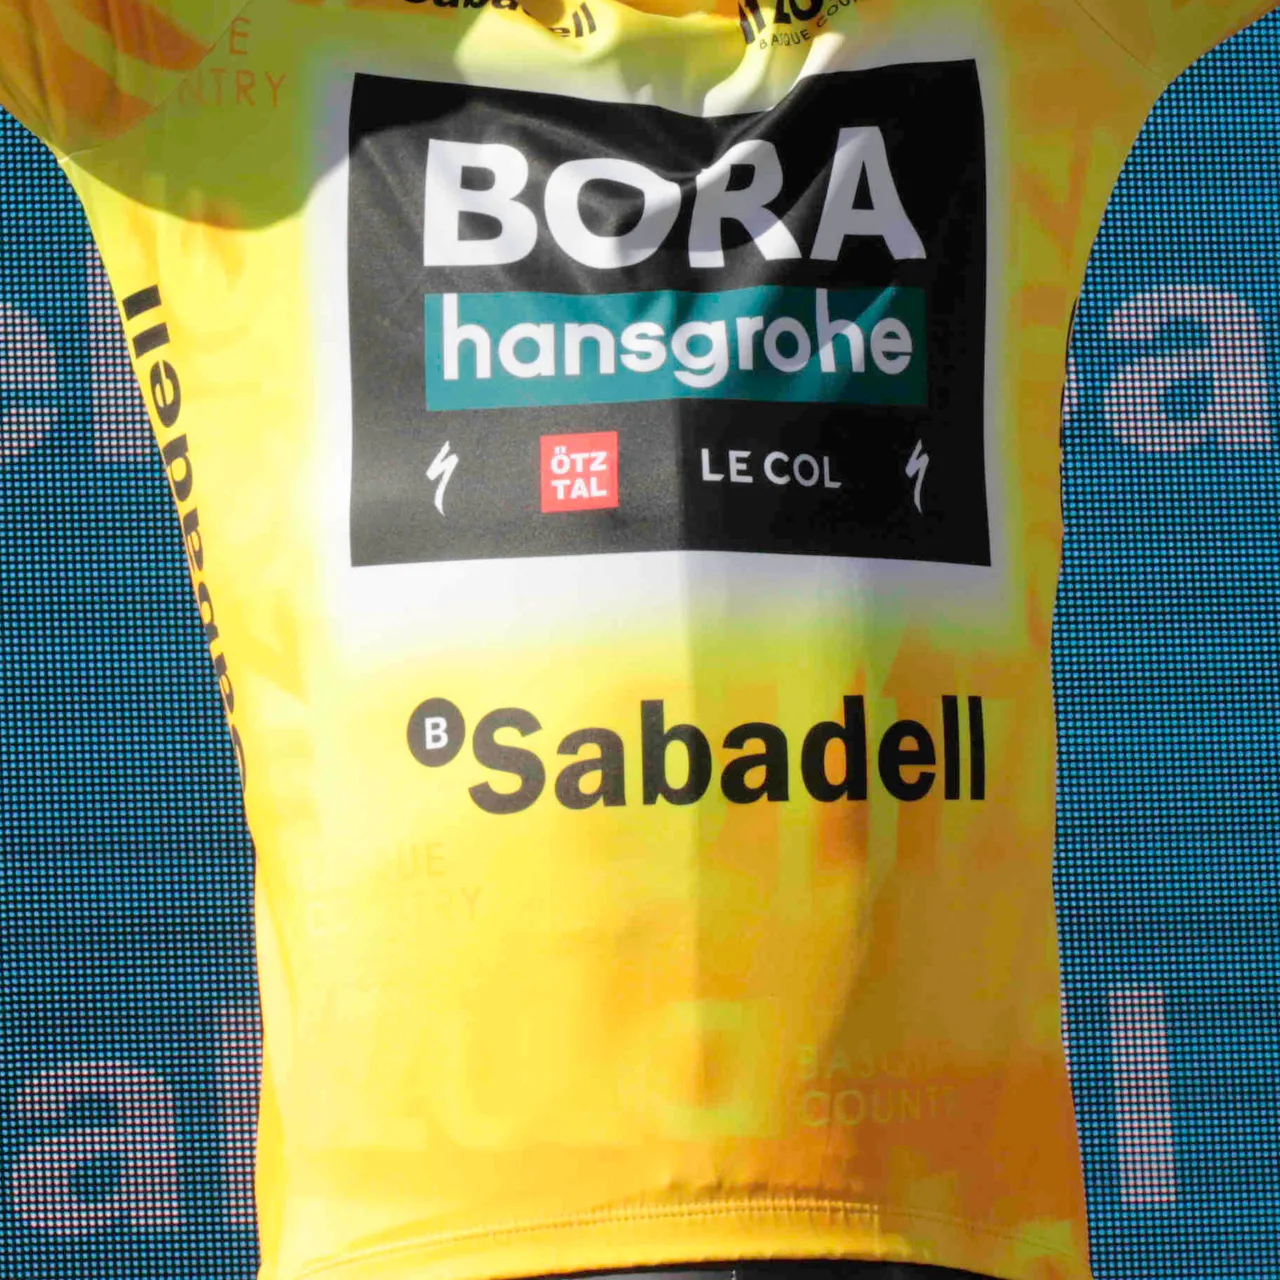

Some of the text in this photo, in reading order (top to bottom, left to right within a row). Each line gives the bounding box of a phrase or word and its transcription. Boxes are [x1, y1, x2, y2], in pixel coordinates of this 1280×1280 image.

[422, 125, 928, 270] BORA
[441, 287, 914, 389] hansgrohe
[551, 446, 608, 476] ÖTZ
[551, 479, 608, 500] TAL
[701, 448, 842, 489] LE COL
[425, 695, 986, 815] B Sabadell
